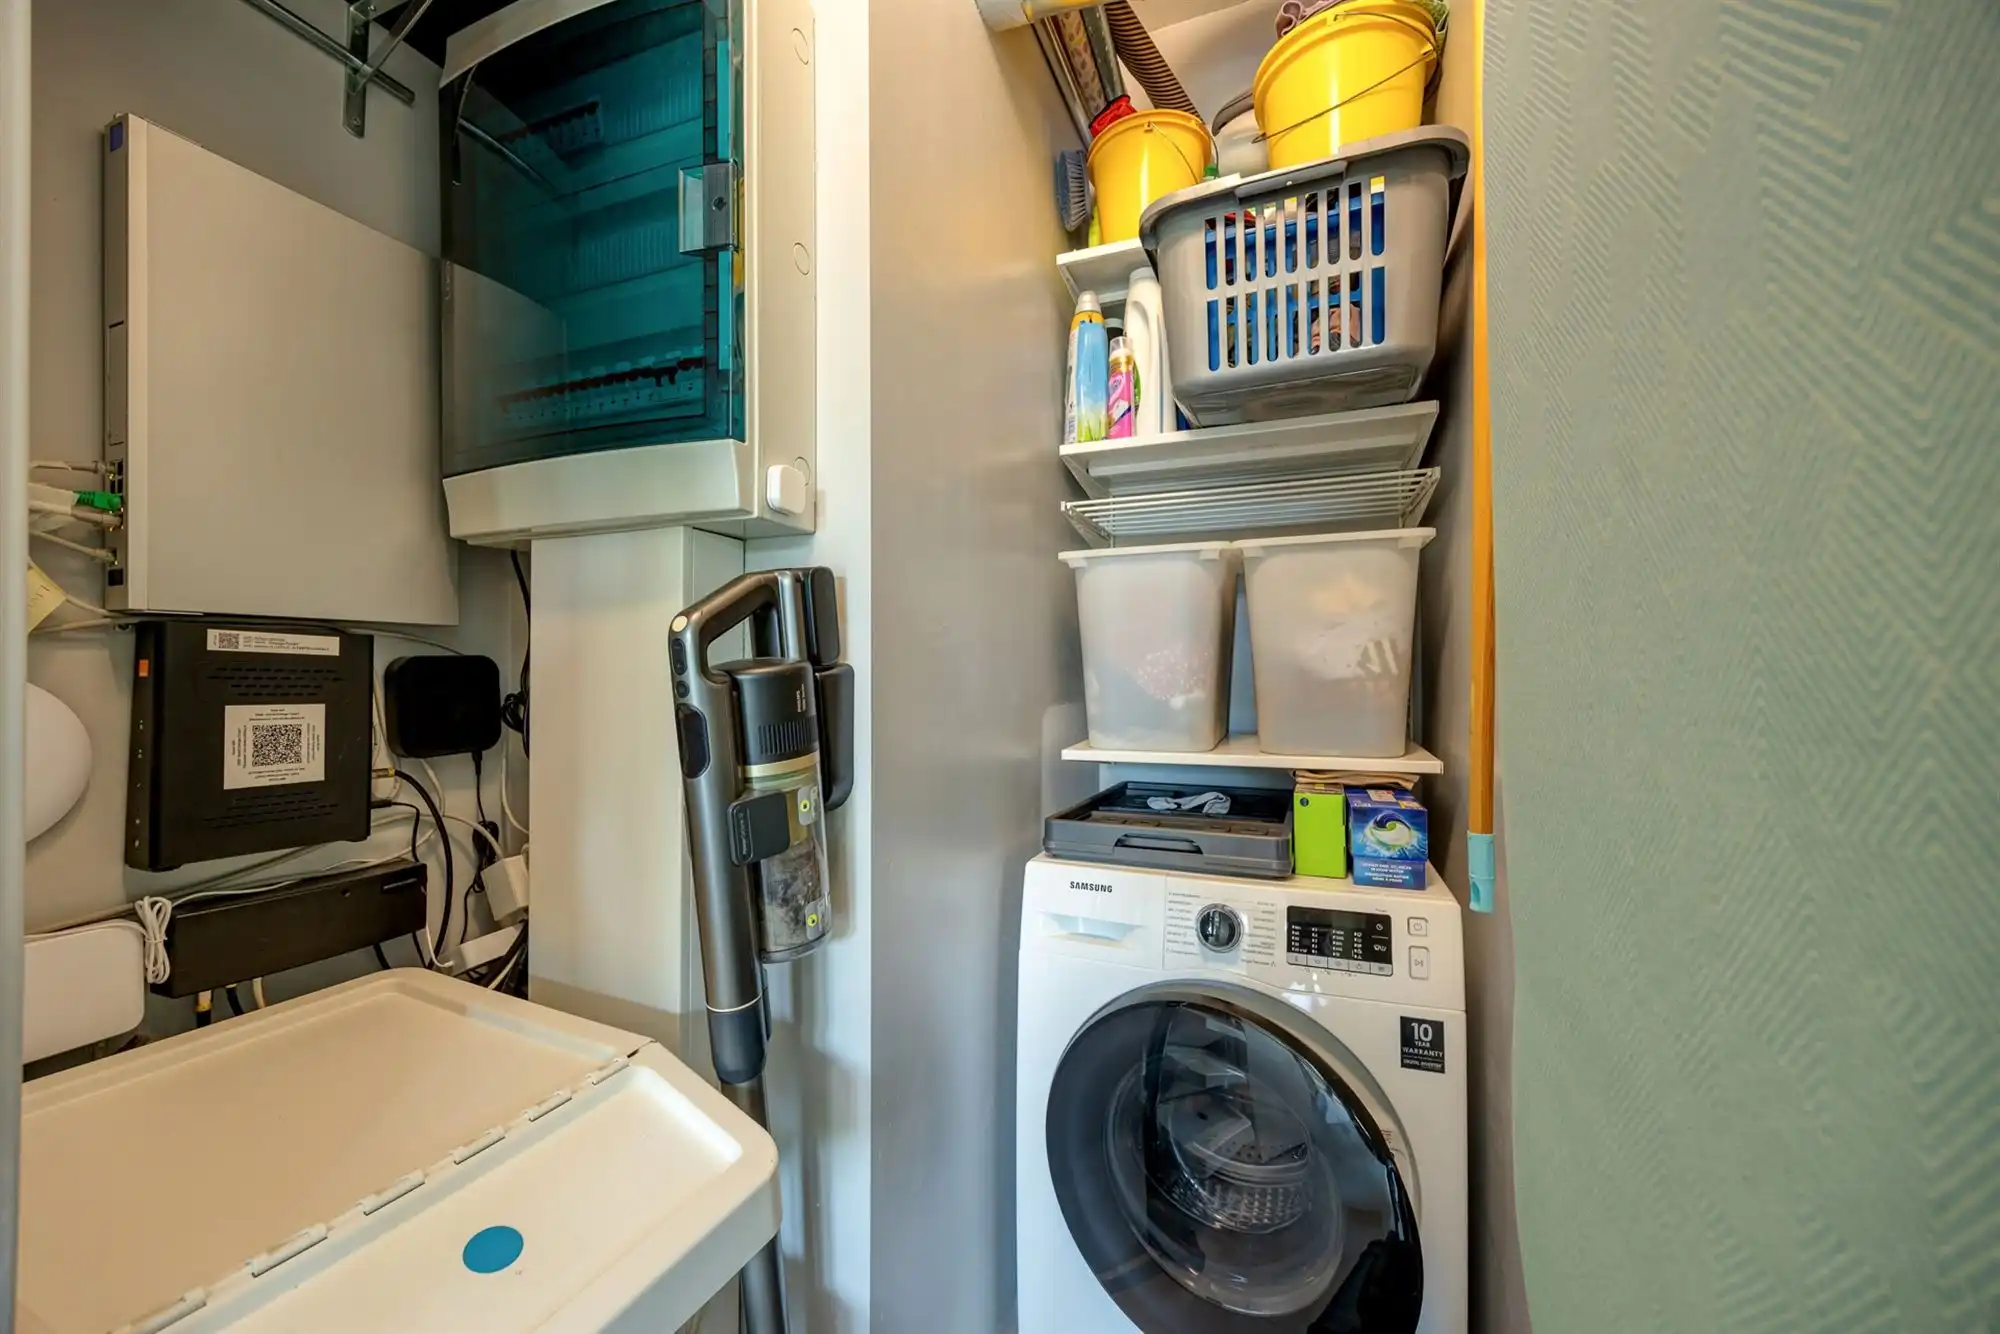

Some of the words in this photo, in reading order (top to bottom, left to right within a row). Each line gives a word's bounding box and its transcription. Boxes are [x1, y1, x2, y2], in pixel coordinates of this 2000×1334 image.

[1069, 881, 1113, 893] SAMSUNG
[1410, 1022, 1433, 1042] 10
[1403, 1047, 1443, 1057] WARRANTY
